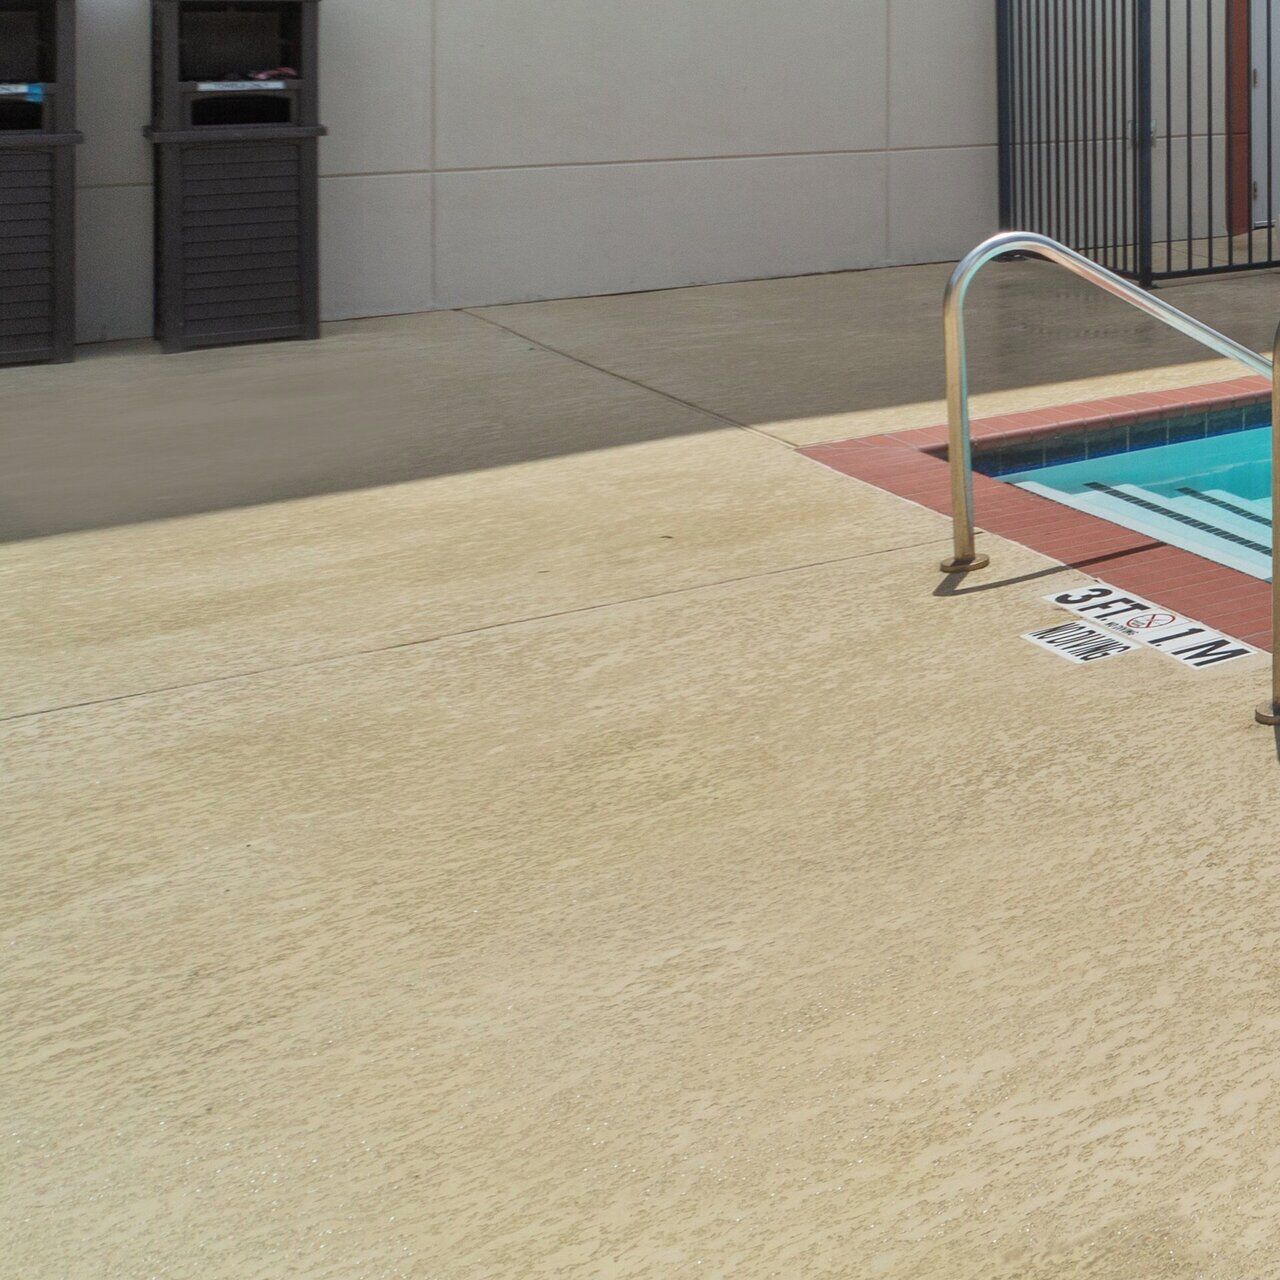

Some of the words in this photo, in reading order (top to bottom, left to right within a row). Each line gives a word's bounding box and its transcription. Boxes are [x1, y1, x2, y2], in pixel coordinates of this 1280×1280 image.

[1028, 622, 1086, 640] NO
[1055, 587, 1113, 604] 3
[1172, 638, 1252, 668] M
[1046, 629, 1131, 661] DIVING
